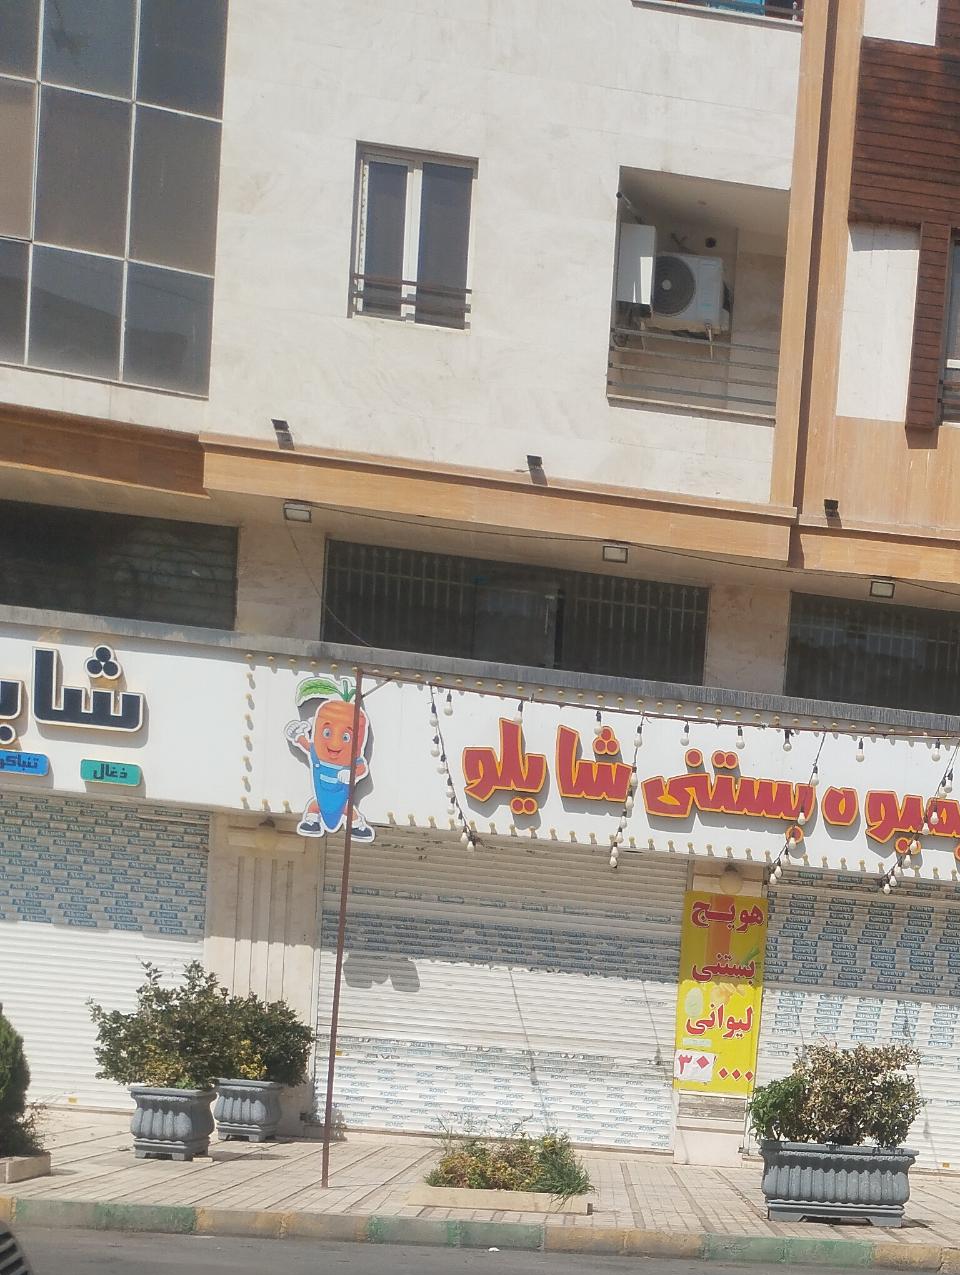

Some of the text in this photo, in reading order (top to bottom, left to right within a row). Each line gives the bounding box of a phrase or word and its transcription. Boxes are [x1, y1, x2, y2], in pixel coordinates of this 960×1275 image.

[93, 763, 128, 780] ذغال
[462, 717, 634, 815] شایلو
[641, 748, 816, 844] بستنی
[691, 900, 764, 932] هویج
[691, 952, 756, 984] بستنی
[685, 1003, 753, 1038] لیوانی
